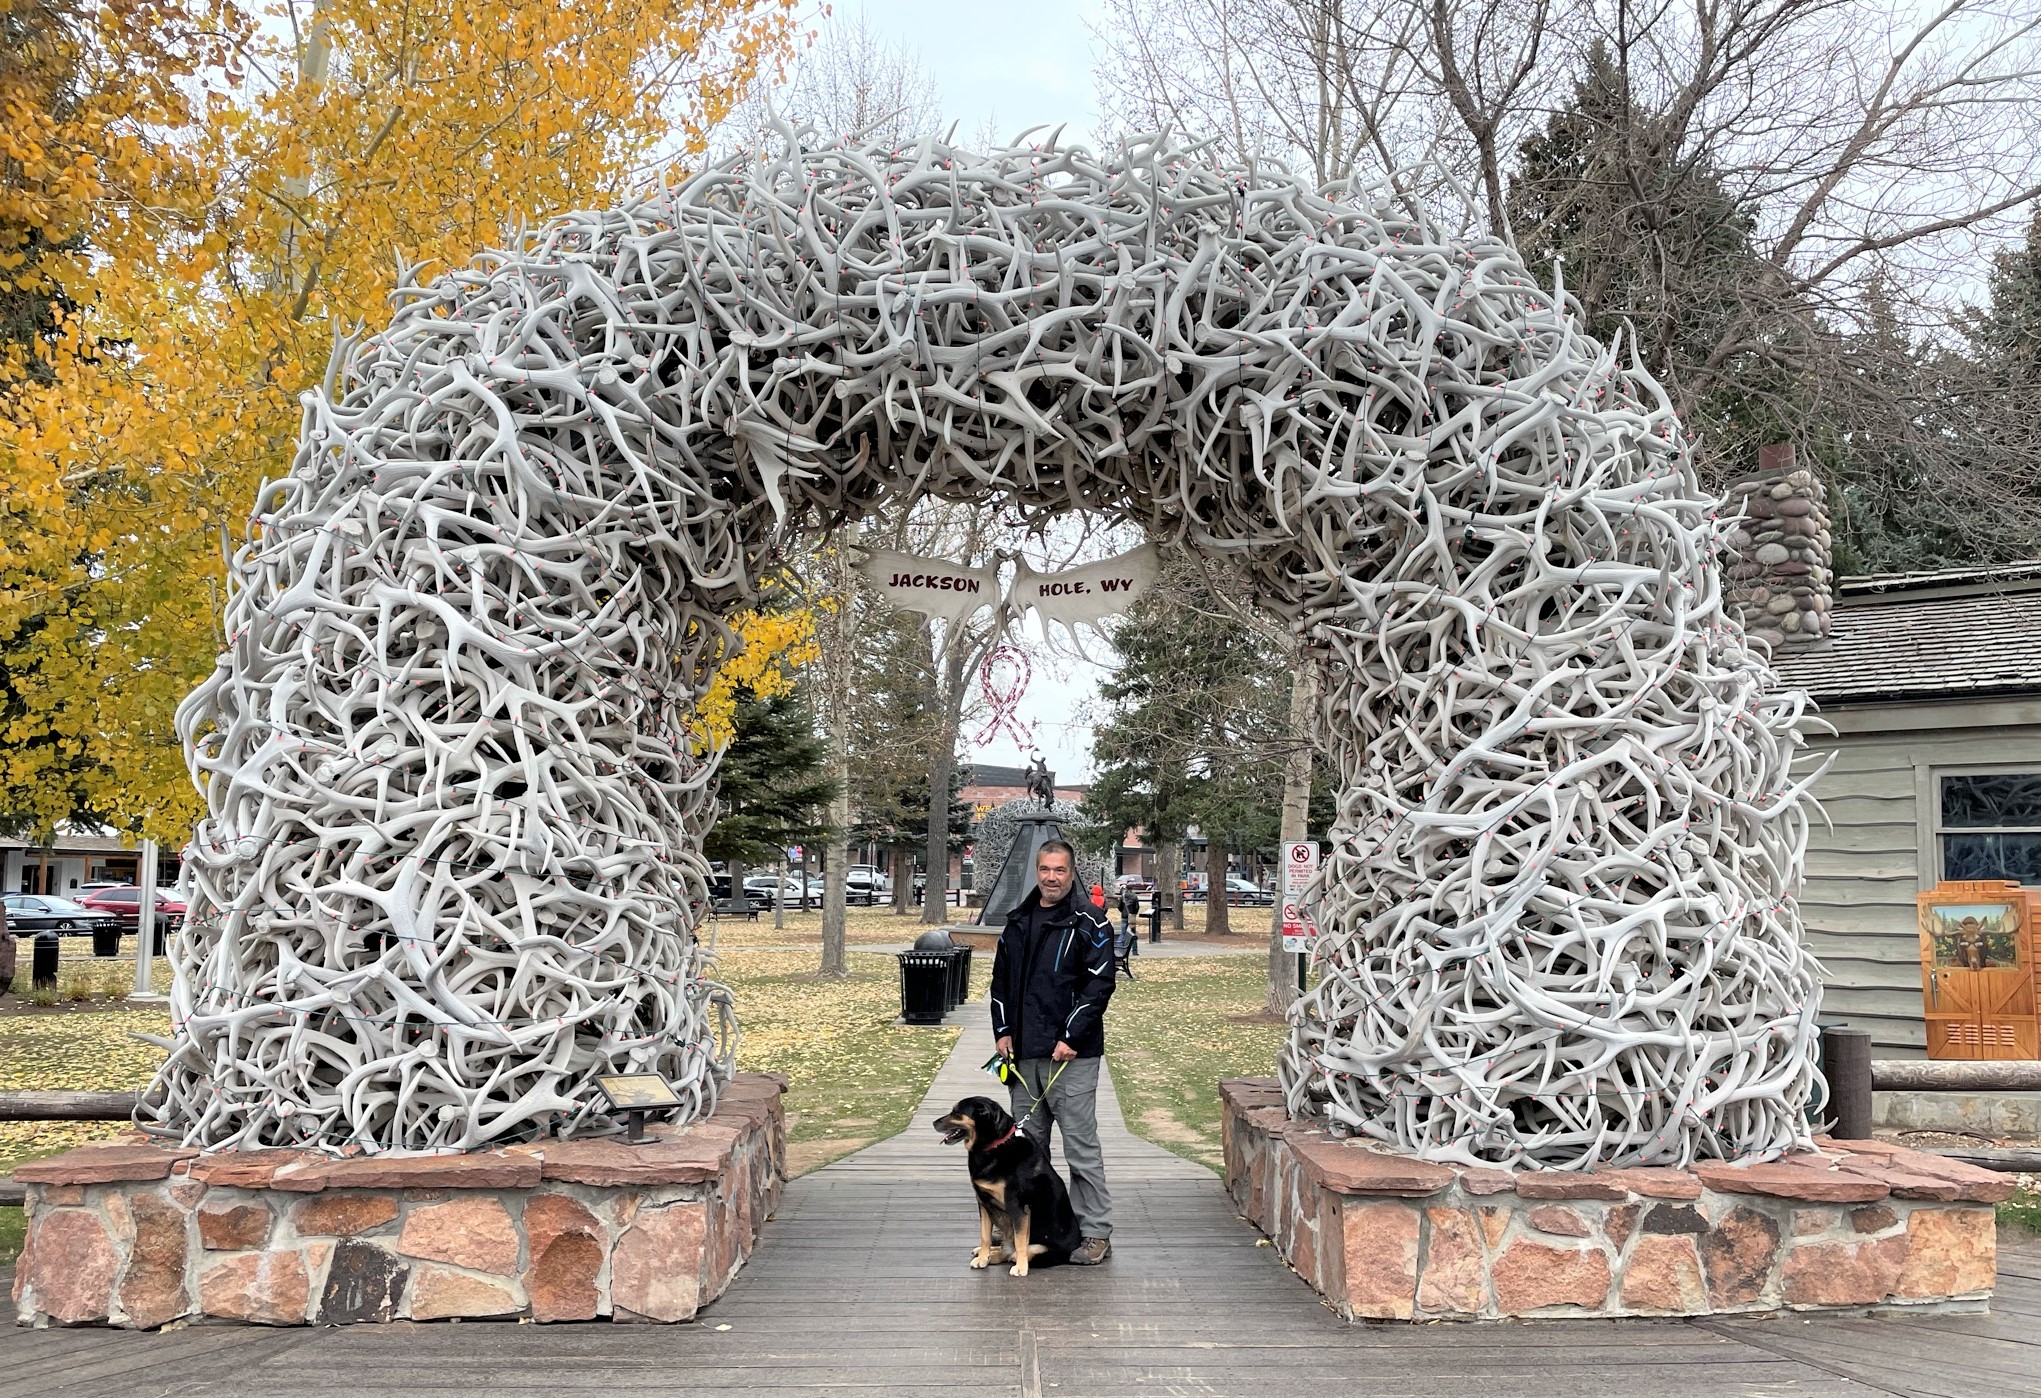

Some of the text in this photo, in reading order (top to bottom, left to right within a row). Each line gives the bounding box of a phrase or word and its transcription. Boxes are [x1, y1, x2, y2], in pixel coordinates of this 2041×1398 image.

[888, 573, 1133, 597] JACKSON HOLE, WY
